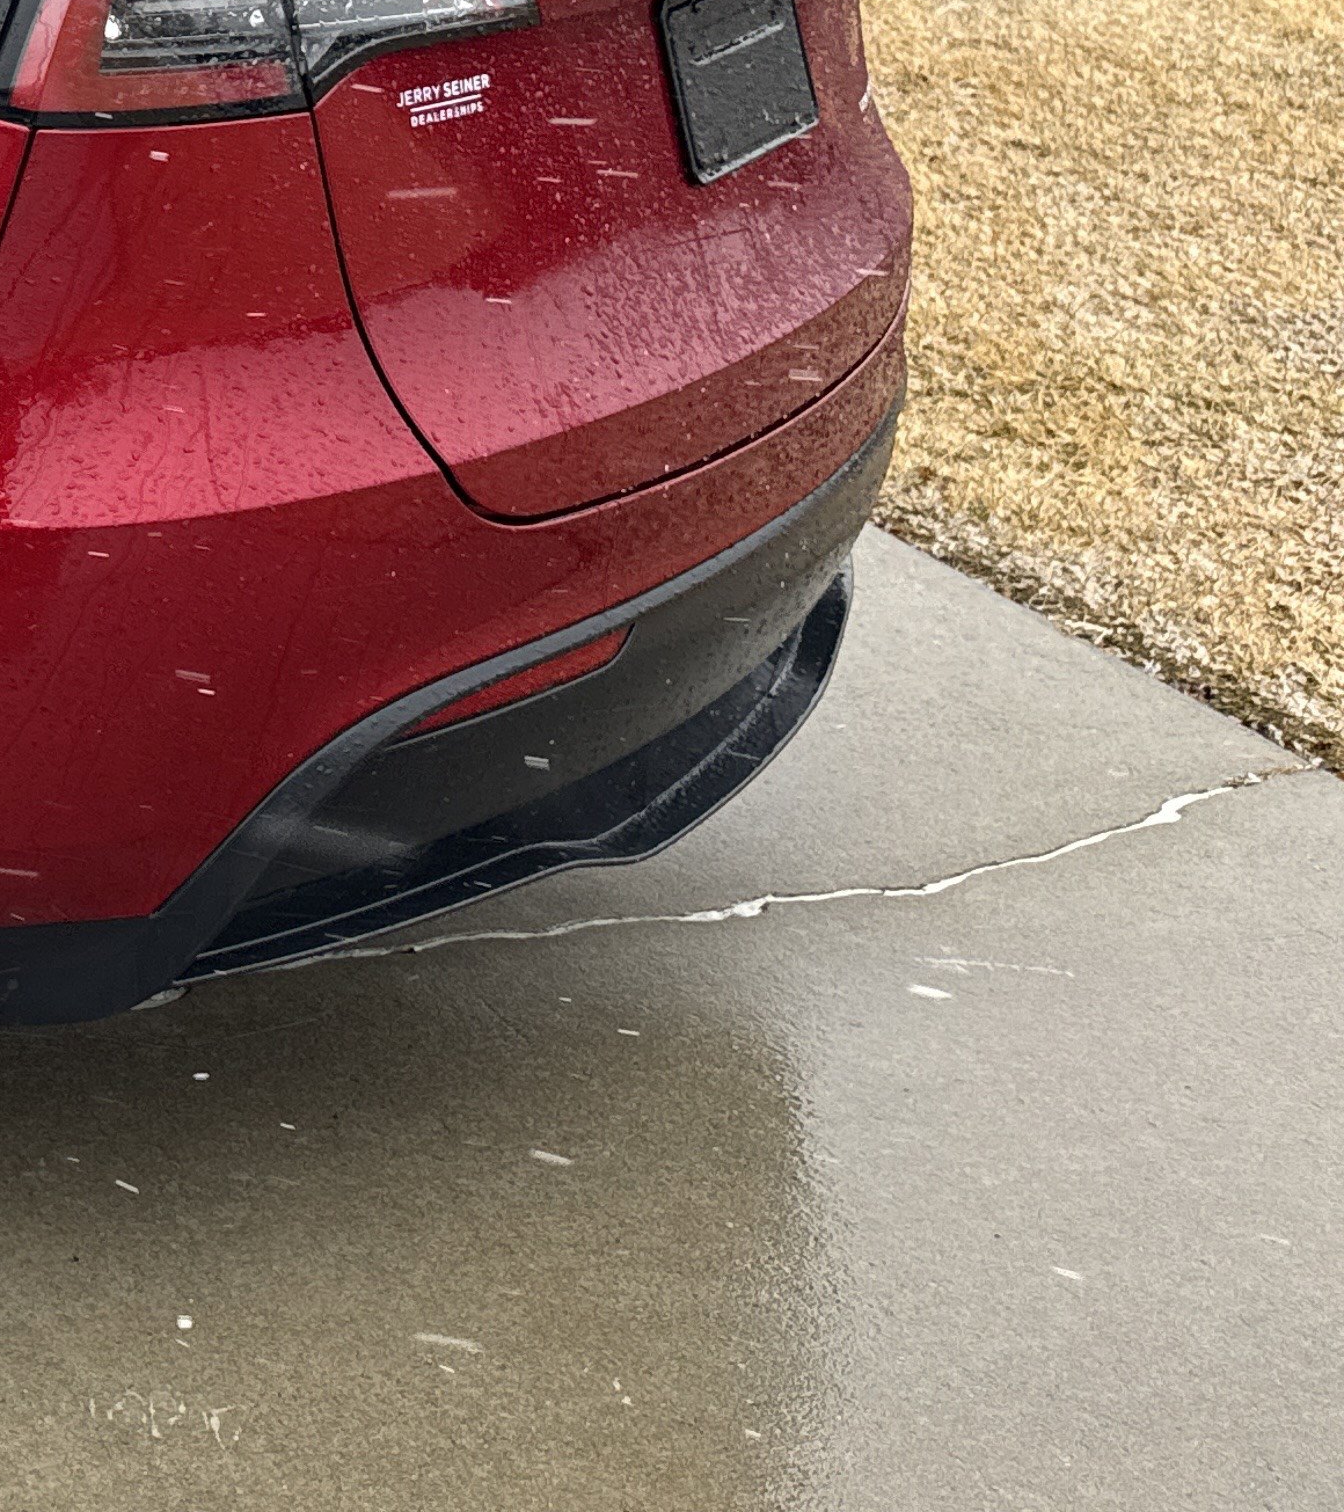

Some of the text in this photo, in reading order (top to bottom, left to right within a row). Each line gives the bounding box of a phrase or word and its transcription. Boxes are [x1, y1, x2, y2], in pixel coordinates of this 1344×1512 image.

[396, 73, 491, 108] JERRY SEINER
[410, 100, 484, 127] DEALERSHIPS
